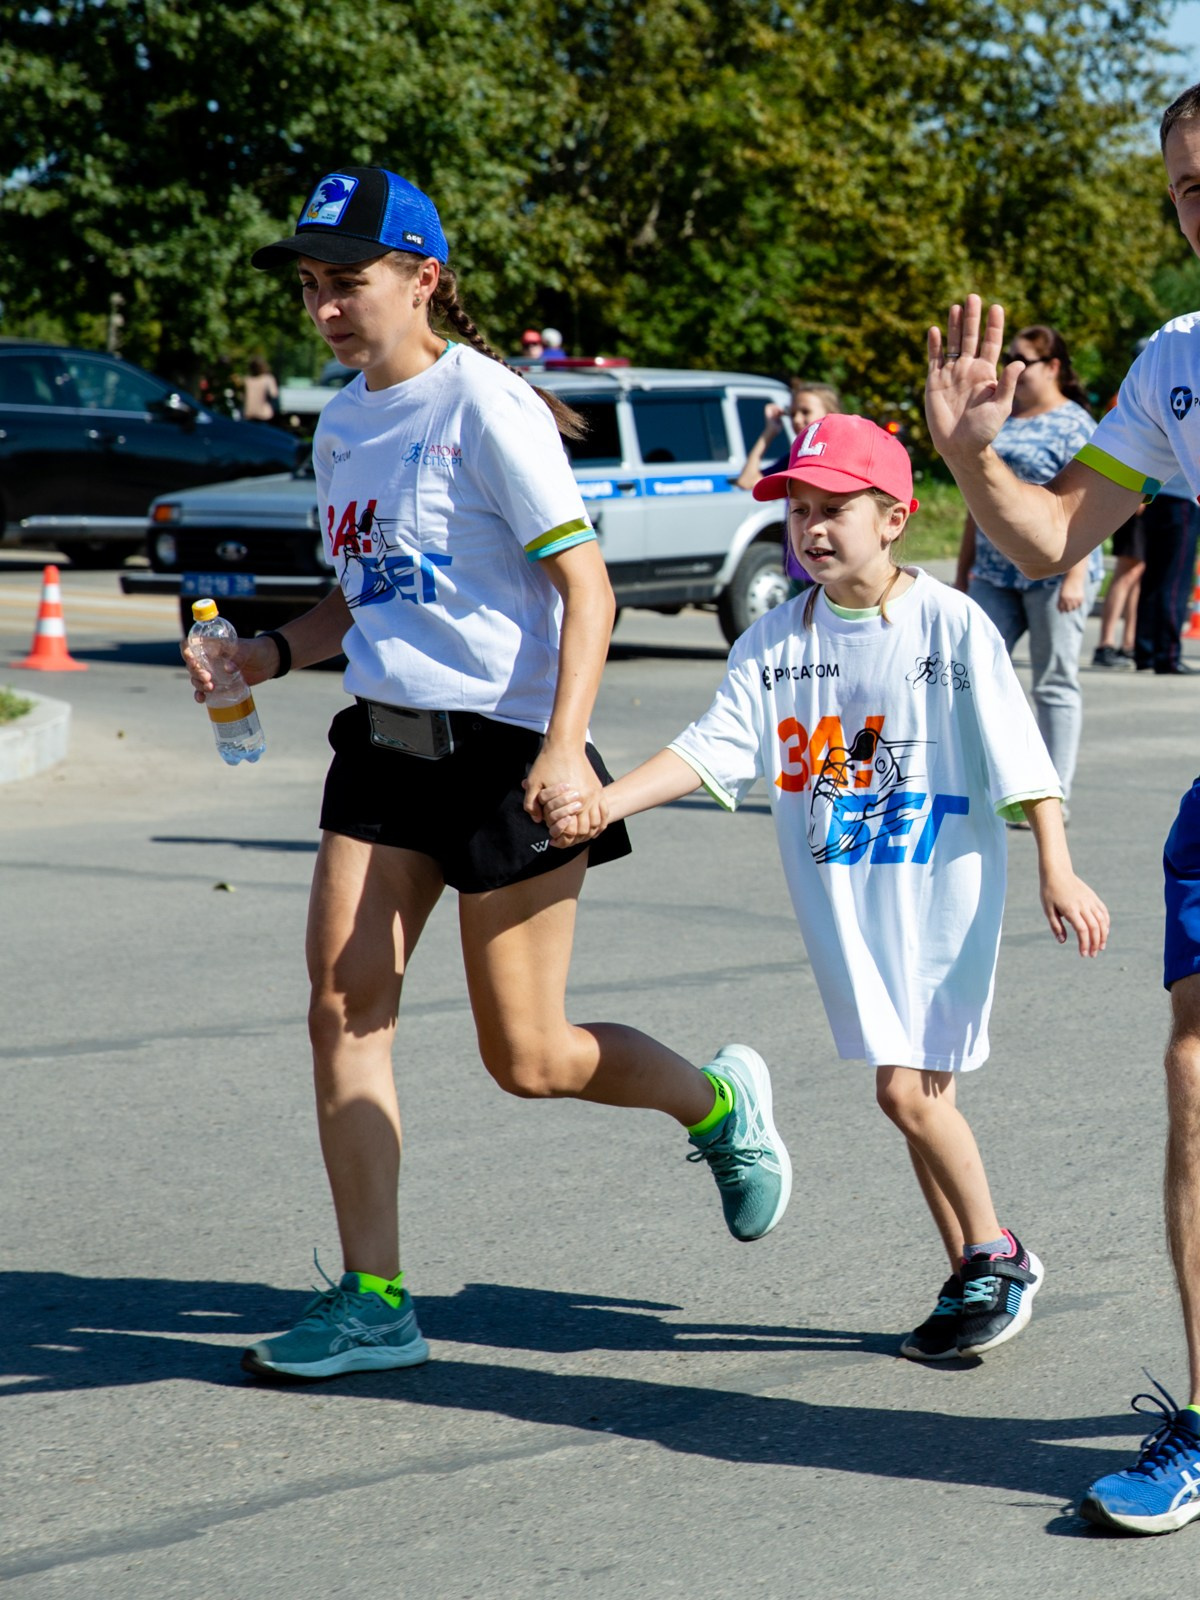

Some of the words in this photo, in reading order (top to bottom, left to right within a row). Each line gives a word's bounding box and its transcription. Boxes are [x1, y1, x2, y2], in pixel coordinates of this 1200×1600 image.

[423, 455, 463, 467] СПОРТ
[430, 444, 462, 457] АТОМ
[797, 422, 827, 457] L
[360, 552, 453, 607] БЕГ
[774, 715, 885, 793] ЗА!
[825, 791, 970, 865] БЕГ
